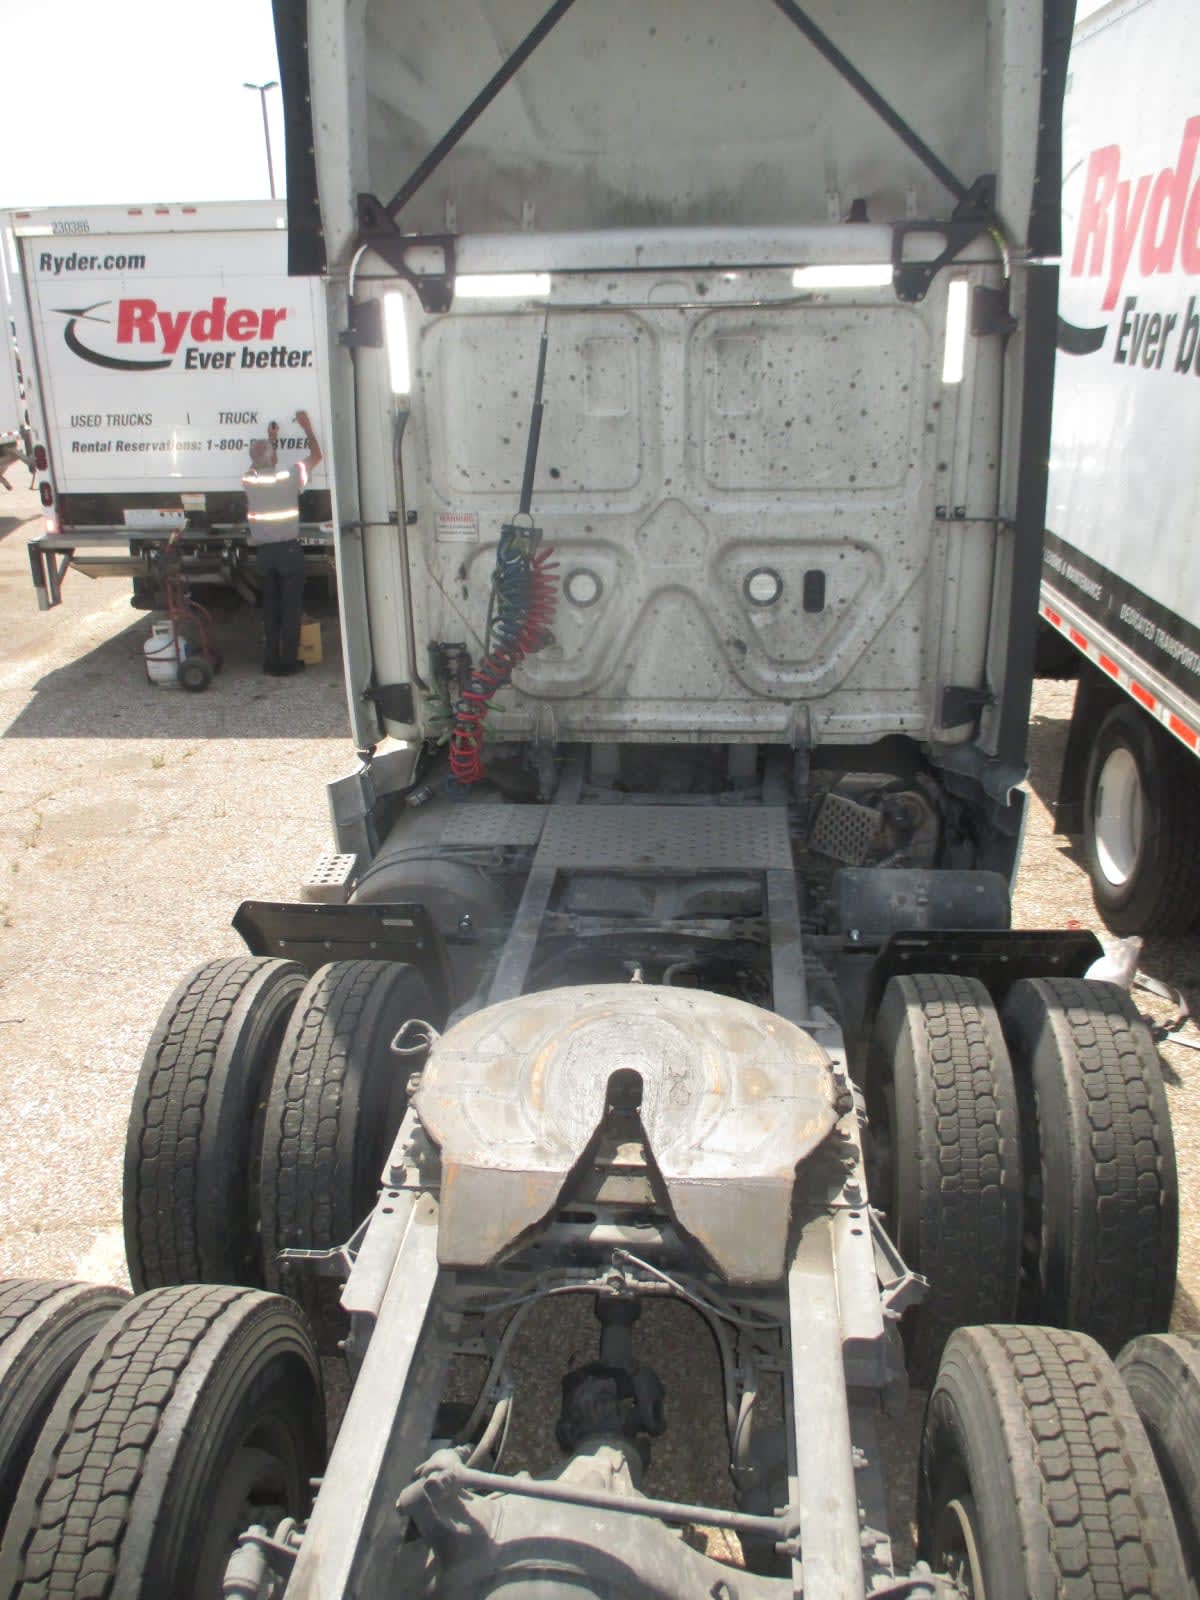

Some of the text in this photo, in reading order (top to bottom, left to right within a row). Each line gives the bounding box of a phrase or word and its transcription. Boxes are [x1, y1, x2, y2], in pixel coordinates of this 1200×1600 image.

[39, 253, 146, 275] Ryder.com
[116, 297, 287, 355] Ryder
[1113, 296, 1178, 369] Ever
[184, 346, 313, 370] Ever better.
[71, 411, 258, 428] USED TRUCKS TRUCK
[72, 440, 111, 453] Rental
